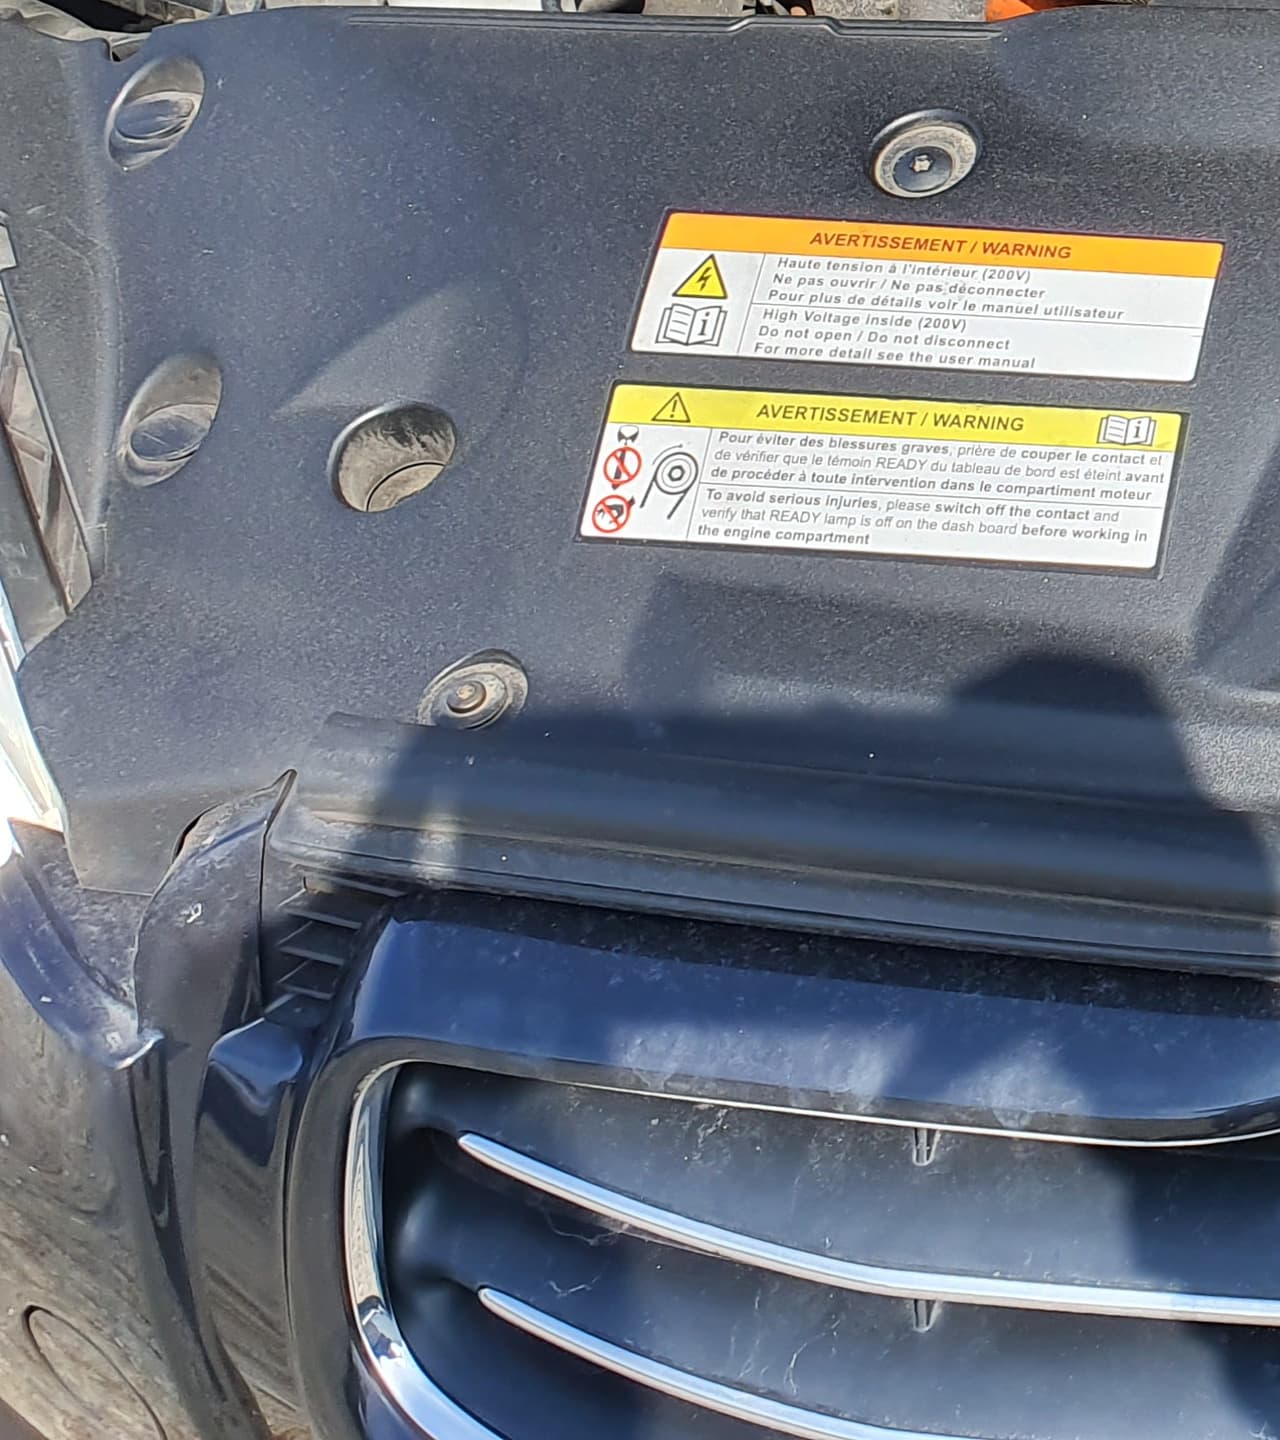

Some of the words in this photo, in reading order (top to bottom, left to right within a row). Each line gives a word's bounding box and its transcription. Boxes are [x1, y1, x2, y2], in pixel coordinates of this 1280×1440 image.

[809, 232, 967, 253] AVERTISSEMENT
[970, 241, 978, 253] /
[982, 242, 1072, 259] WARNING
[778, 257, 821, 270] Haute
[827, 261, 883, 273] tension
[982, 269, 1031, 283] (200V)
[773, 273, 792, 284] Ne
[797, 277, 824, 288] pas
[830, 279, 877, 289] ouvrir
[880, 279, 887, 289] /
[891, 280, 910, 291] Ne
[915, 284, 943, 294] pas
[949, 283, 1045, 298] déconnecter
[768, 290, 804, 301] Pour
[809, 293, 841, 304] plus
[847, 295, 865, 305] de
[871, 297, 922, 309] détails
[928, 300, 958, 310] voir
[963, 300, 976, 312] le
[982, 304, 1038, 315] manuel
[1044, 307, 1125, 320] utilisateur
[763, 309, 798, 323] High
[804, 311, 860, 326] Voltage
[865, 313, 913, 327] inside
[918, 318, 967, 333] (200V)
[758, 326, 779, 337] Do
[785, 327, 809, 339] not
[818, 331, 851, 342] open
[856, 331, 863, 341] /
[868, 332, 888, 343] Do
[894, 333, 918, 345] not
[924, 335, 1010, 350] disconnect
[754, 342, 780, 354] For
[785, 347, 823, 357] more
[829, 346, 871, 359] detail
[877, 351, 904, 361] see
[910, 349, 933, 363] the
[939, 355, 973, 365] user
[978, 356, 1036, 369] manual
[757, 404, 917, 426] AVERTISSEMENT
[920, 412, 928, 426] /
[933, 413, 1024, 431] WARNING
[719, 432, 752, 443] Pour
[757, 434, 794, 446] éviter
[800, 436, 824, 448] des
[829, 437, 897, 451] blessures
[902, 443, 953, 456] graves,
[957, 446, 996, 458] prière
[1000, 447, 1016, 458] de
[1021, 449, 1071, 462] couper
[1076, 450, 1087, 462] le
[1092, 452, 1145, 464] contact
[1150, 455, 1162, 466] et
[715, 450, 731, 460] de
[736, 451, 779, 463] vérifier
[783, 455, 808, 466] que
[812, 455, 823, 465] le
[827, 457, 872, 468] témoin
[876, 457, 928, 470] READY
[932, 461, 947, 472] du
[951, 462, 1000, 475] tableau
[1005, 465, 1021, 476] de
[1026, 466, 1055, 478] bord
[1060, 470, 1080, 480] est
[1084, 468, 1121, 481] éteint
[1125, 473, 1164, 483] avant
[711, 467, 727, 477] de
[731, 470, 794, 482] procéder
[811, 473, 847, 484] toute
[851, 473, 935, 489] intervention
[941, 479, 974, 491] dans
[980, 481, 992, 492] le
[997, 483, 1095, 498] compartiment
[1100, 490, 1152, 501] moteur
[707, 489, 721, 500] To
[726, 491, 764, 503] avoid
[769, 494, 821, 506] serious
[825, 495, 881, 511] injuries,
[886, 499, 930, 512] please
[935, 503, 981, 515] switch
[986, 504, 1006, 516] off
[1009, 505, 1031, 517] the
[1036, 509, 1089, 520] contact
[1094, 511, 1119, 522] and
[698, 525, 719, 536] the
[724, 528, 771, 540] engine
[776, 533, 870, 545] compartment
[702, 508, 737, 522] verify
[741, 510, 766, 521] that
[770, 511, 821, 524] READY
[824, 515, 856, 527] lamp
[861, 515, 870, 526] is
[875, 517, 893, 528] off
[896, 521, 913, 529] on
[917, 518, 938, 530] the
[942, 521, 974, 533] dash
[979, 523, 1017, 535] board
[1022, 526, 1067, 537] before
[1073, 528, 1129, 543] working
[1135, 530, 1147, 542] in
